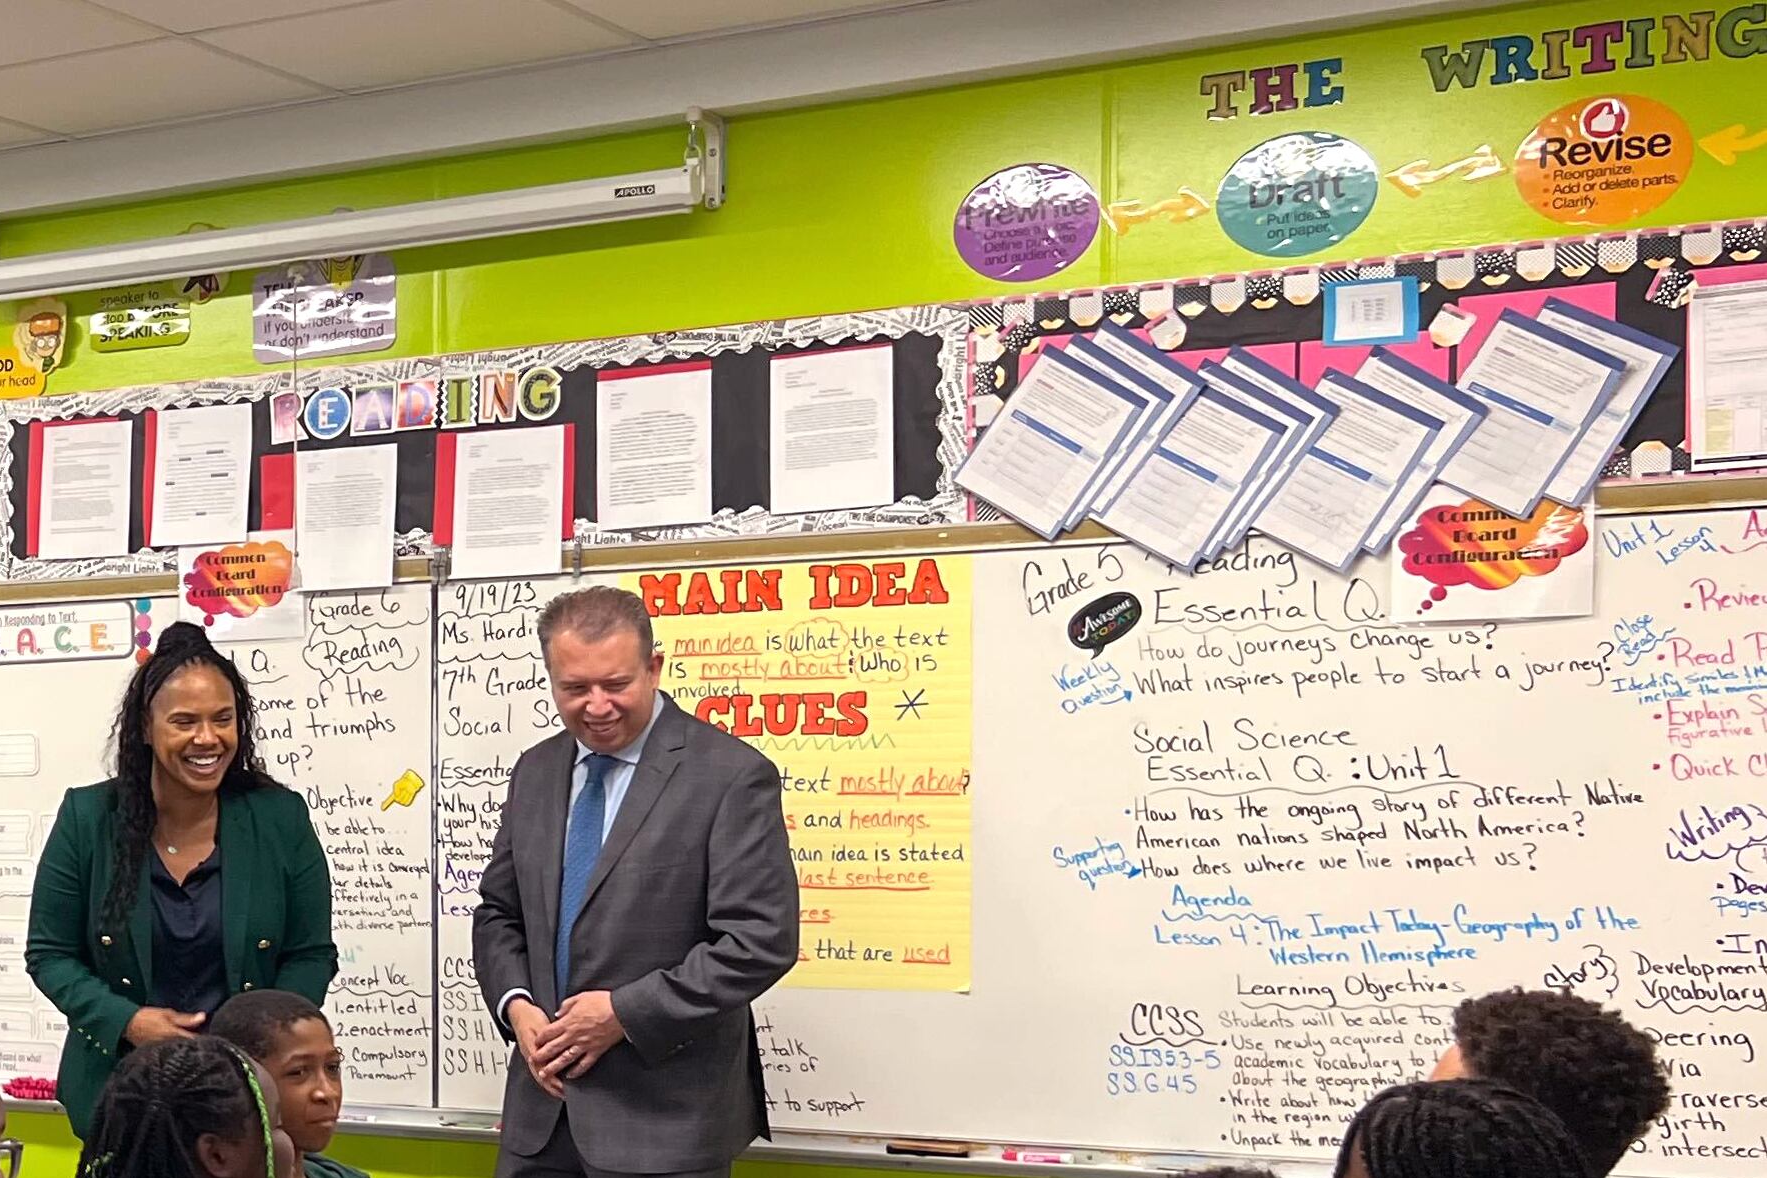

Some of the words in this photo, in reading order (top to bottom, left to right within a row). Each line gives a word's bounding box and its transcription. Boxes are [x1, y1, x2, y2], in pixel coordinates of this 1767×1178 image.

[1200, 57, 1345, 121] THE
[1422, 4, 1767, 92] WRITING
[1539, 131, 1671, 169] Revise
[616, 187, 654, 197] APOLLO
[1248, 174, 1345, 210] Draft
[1553, 182, 1581, 195] Add
[1583, 182, 1596, 192] or
[1599, 176, 1640, 191] delete
[1642, 173, 1678, 188] parts.
[1552, 196, 1598, 209] Clarify.
[15, 375, 36, 387] head
[270, 368, 561, 445] READING
[639, 569, 783, 618] MAIN
[809, 558, 949, 610] IDEA
[1022, 558, 1095, 616] Grade
[1097, 546, 1124, 582] 5
[454, 581, 538, 618] 9/19/23
[16, 628, 44, 656] A.
[53, 625, 80, 653] C.
[89, 623, 114, 651] E.
[310, 629, 404, 666] Reading
[675, 637, 712, 653] main
[715, 631, 755, 652] idea
[766, 630, 783, 651] is
[788, 628, 840, 651] what
[850, 625, 886, 648] the
[895, 625, 950, 647] text
[669, 657, 687, 679] is
[699, 657, 769, 682] mostly
[781, 653, 847, 677] about
[860, 653, 902, 673] Who
[915, 657, 938, 672] is
[1133, 662, 1194, 695] What
[1204, 670, 1284, 695] inspires
[1291, 661, 1362, 698] people
[1376, 656, 1405, 686] to
[1421, 654, 1481, 684] start
[1495, 664, 1511, 680] a
[1519, 641, 1615, 691] journey?
[442, 702, 513, 738] Social
[694, 691, 869, 738] CLUES
[1133, 720, 1214, 753] Social
[1234, 718, 1358, 751] Science
[783, 767, 831, 793] text
[840, 767, 905, 802] mostly
[1134, 795, 1177, 822] How
[1188, 797, 1223, 821] has
[1234, 796, 1268, 820] the
[1287, 803, 1363, 831] ongoing
[1372, 793, 1427, 822] story
[1437, 790, 1460, 809] of
[1473, 779, 1572, 808] different
[1584, 778, 1645, 806] Native
[804, 810, 842, 828] and
[849, 809, 930, 837] headings.
[1136, 825, 1221, 849] American
[1237, 823, 1309, 846] nations
[1320, 822, 1388, 848] shaped
[1404, 817, 1468, 840] North
[1478, 810, 1585, 837] America?
[832, 844, 868, 862] idea
[874, 842, 890, 861] is
[899, 843, 964, 862] stated
[1172, 884, 1252, 917] Agenda
[815, 939, 858, 961] that
[863, 947, 894, 962] are
[903, 944, 951, 960] used
